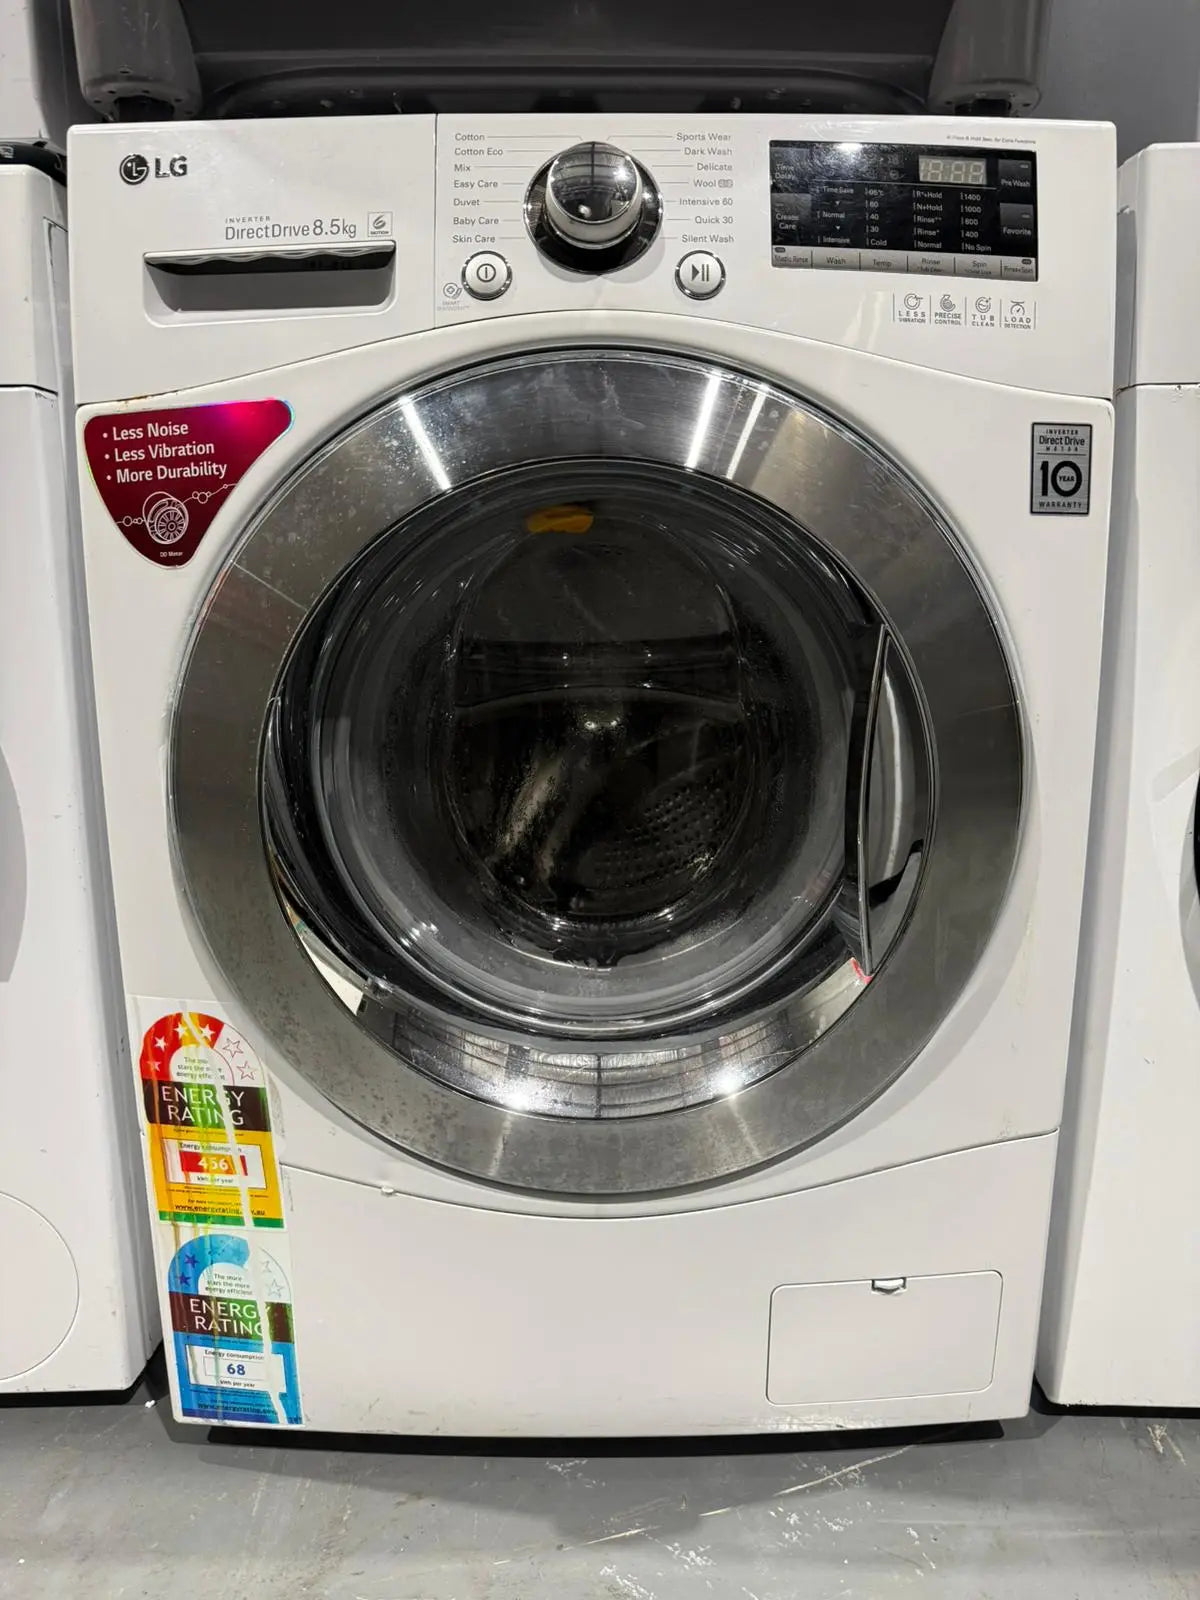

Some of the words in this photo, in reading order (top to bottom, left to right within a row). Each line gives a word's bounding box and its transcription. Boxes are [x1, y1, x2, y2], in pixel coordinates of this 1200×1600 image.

[455, 133, 485, 141] Cotton
[676, 132, 706, 142] Sports
[708, 133, 731, 141] Wear
[454, 148, 484, 156] Cotton
[487, 148, 503, 156] Eco
[684, 147, 705, 155] Dark
[707, 147, 733, 155] Wash
[154, 155, 188, 178] LG
[454, 164, 471, 172] Mix
[697, 162, 733, 171] Delicate
[453, 180, 475, 189] Easy
[477, 180, 498, 188] Care
[693, 179, 716, 187] Wool
[1001, 179, 1012, 187] Pre
[1013, 180, 1030, 188] Wash
[453, 198, 480, 206] Duvet
[680, 197, 720, 206] Intensive
[722, 197, 733, 206] 60
[916, 202, 943, 211] N+Hold
[225, 216, 271, 224] INVERTER
[453, 216, 476, 225] Baby
[695, 216, 720, 224] Quick
[722, 216, 733, 224] 30
[1003, 227, 1032, 235] Favorite
[452, 235, 472, 243] Skin
[475, 235, 496, 243] Care
[682, 234, 707, 243] Silent
[709, 235, 734, 243] Wash
[870, 239, 887, 247] Cold
[918, 240, 942, 248] Normal
[965, 243, 975, 251] No
[975, 244, 991, 252] Spin
[826, 256, 846, 264] Wash
[921, 257, 941, 265] Rinse
[972, 260, 987, 268] Spin
[112, 426, 144, 441] Less
[147, 421, 189, 438] Noise
[1039, 435, 1063, 445] Direct
[1064, 436, 1085, 446] Drive
[114, 447, 145, 462] Less
[148, 441, 214, 459] Vibration
[116, 468, 153, 483] More
[157, 461, 227, 480] Durability
[1040, 460, 1082, 497] 10
[167, 1105, 244, 1126] RATING
[198, 1157, 229, 1170] 456
[204, 1349, 225, 1357] Energy
[226, 1352, 264, 1360] consumption
[227, 1363, 246, 1375] 68
